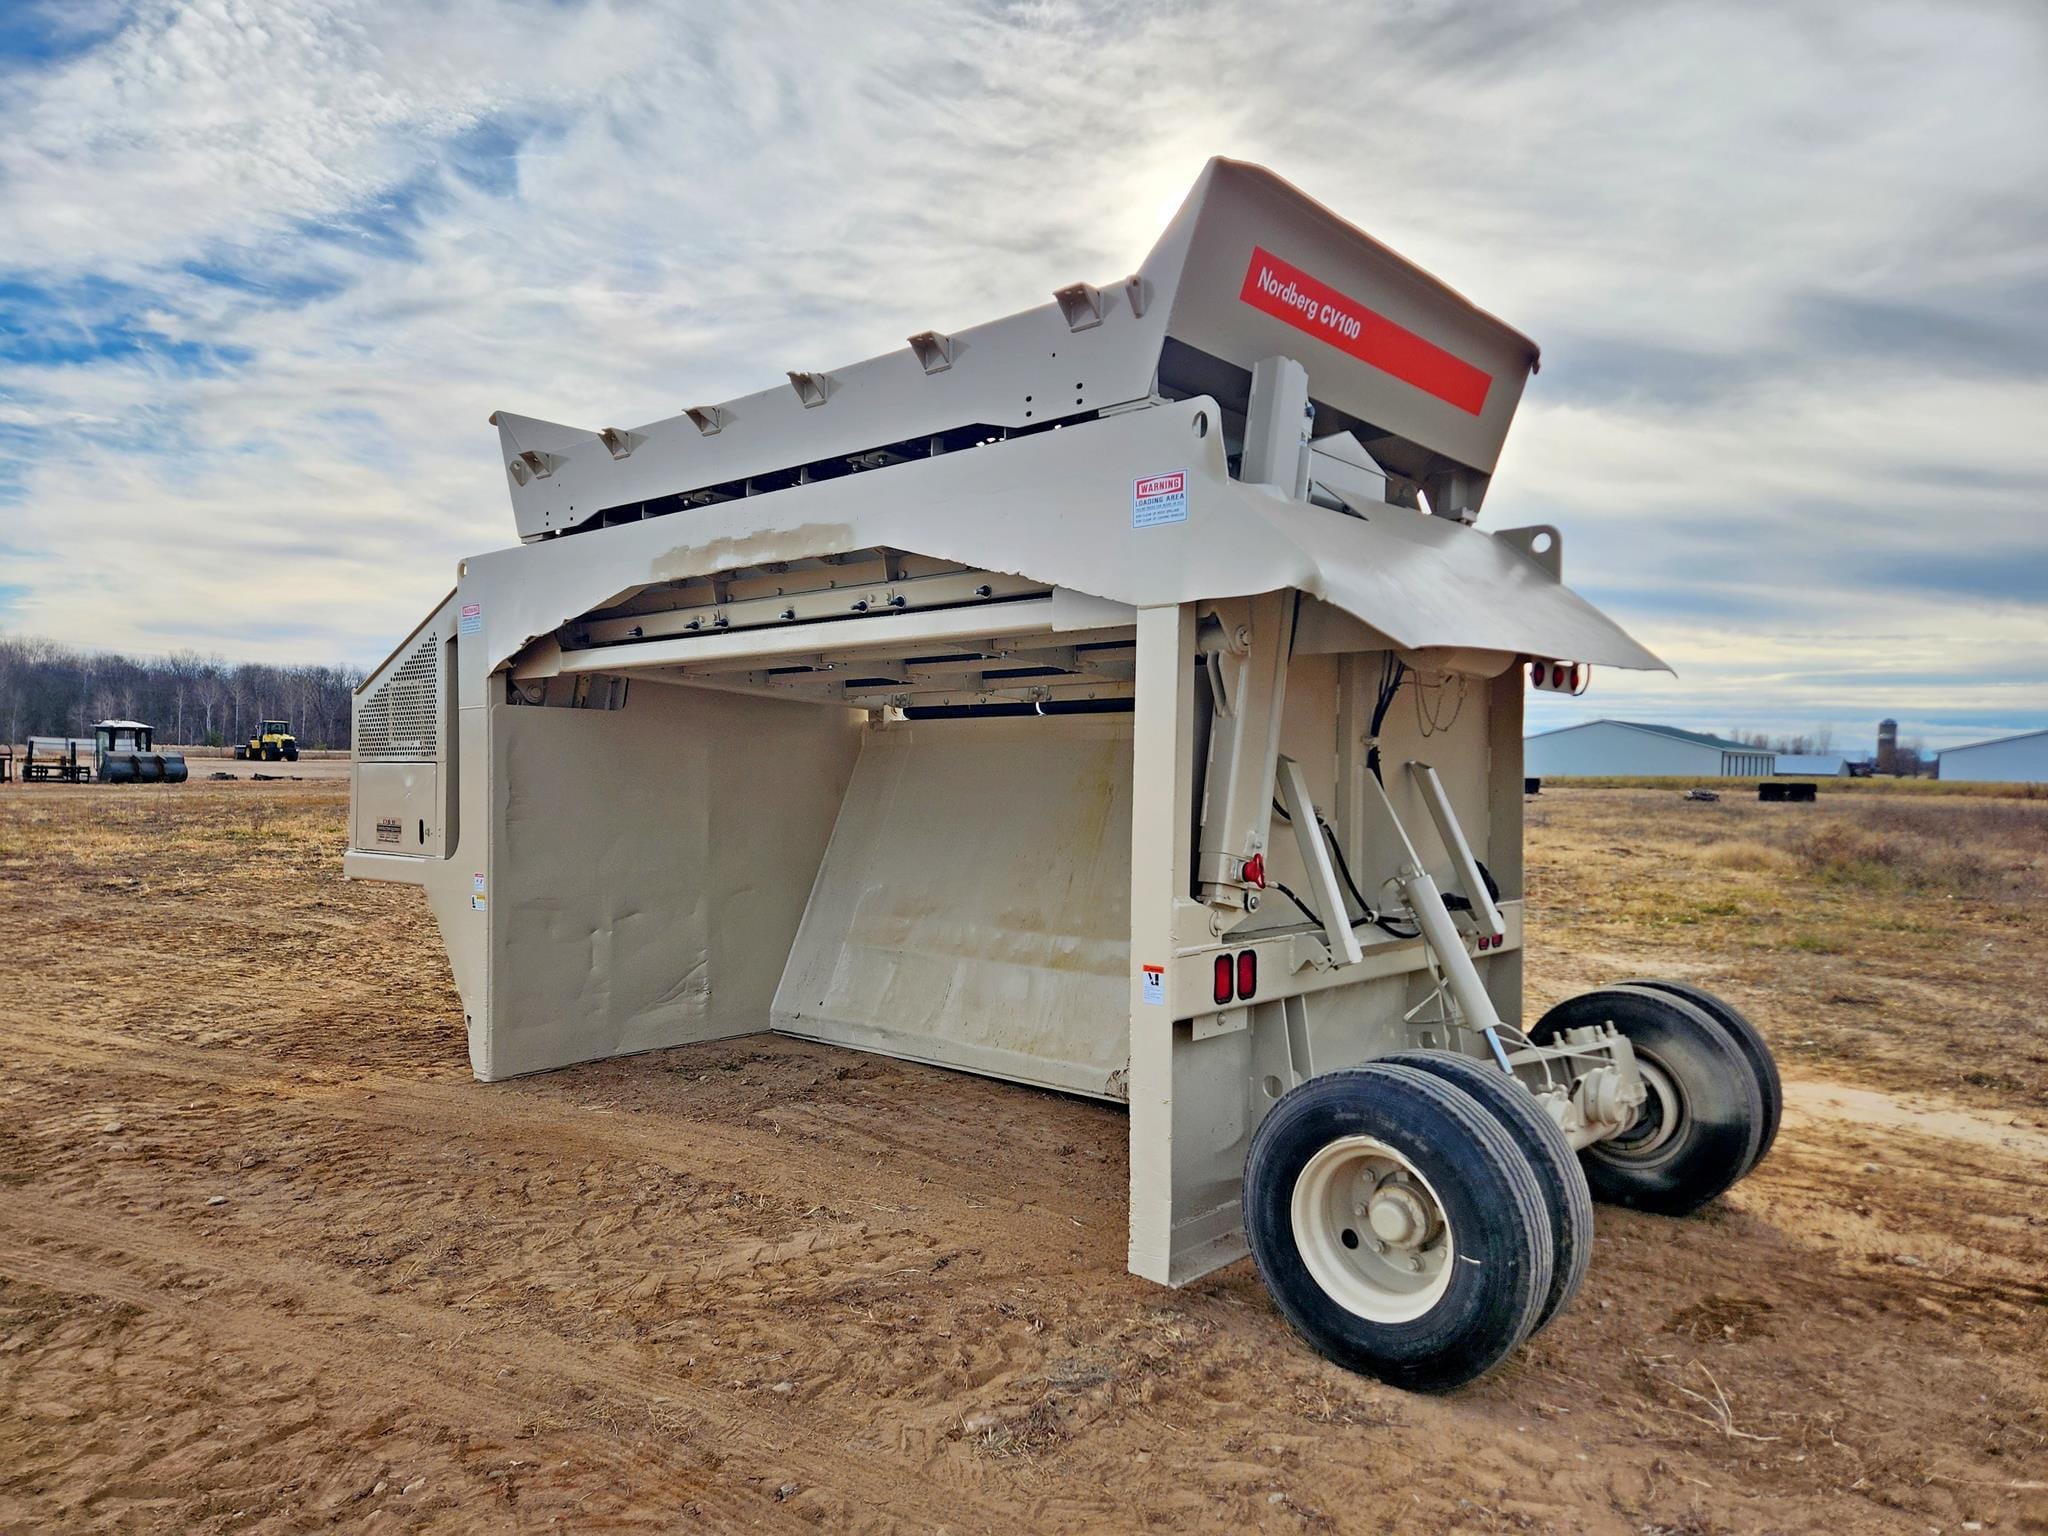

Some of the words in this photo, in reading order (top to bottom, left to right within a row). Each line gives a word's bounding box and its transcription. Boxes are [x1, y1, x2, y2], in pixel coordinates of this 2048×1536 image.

[1257, 266, 1318, 320] Nordberg
[1320, 304, 1361, 340] CV100
[1140, 478, 1180, 493] WARNING
[1166, 493, 1184, 502] AREA
